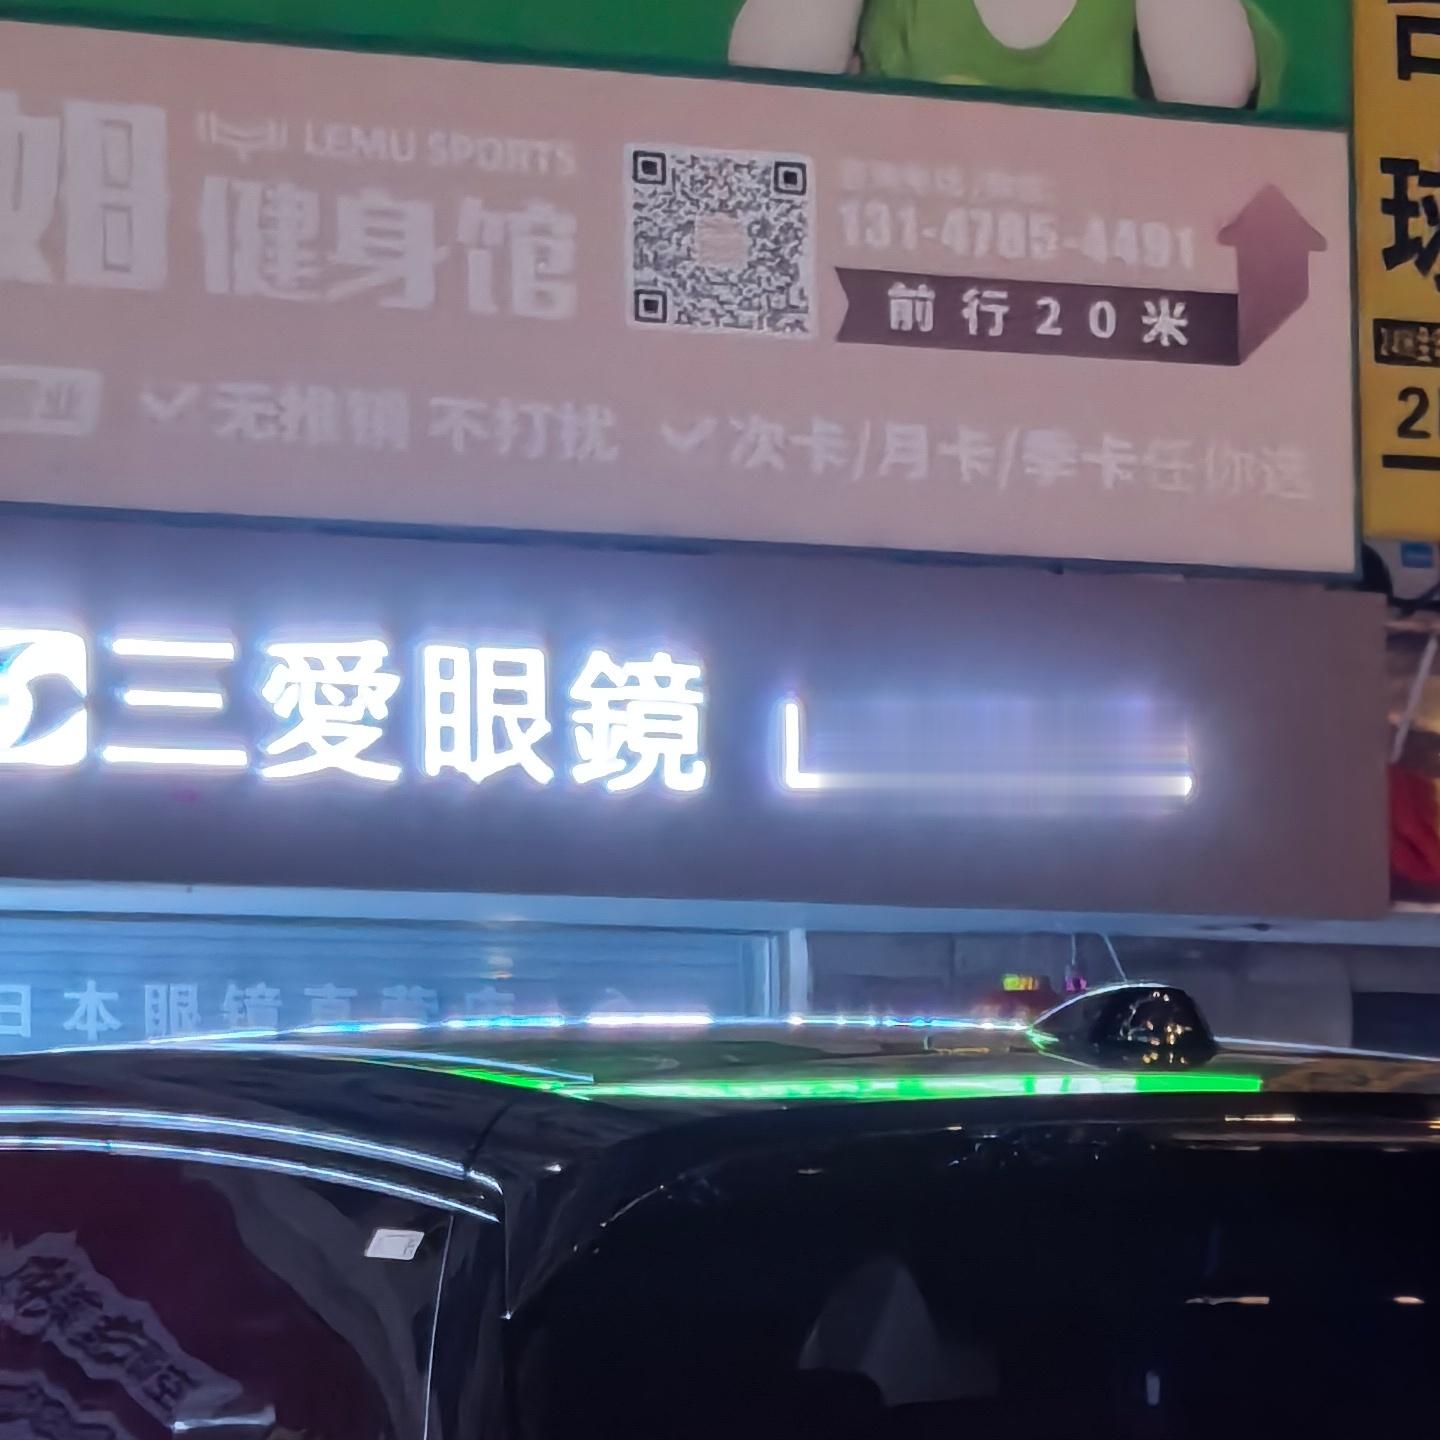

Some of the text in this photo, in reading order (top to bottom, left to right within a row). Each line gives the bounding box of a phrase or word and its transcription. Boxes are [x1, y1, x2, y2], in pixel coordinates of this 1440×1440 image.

[886, 282, 1190, 348] 前行20米
[102, 637, 708, 792] 三愛眼鏡
